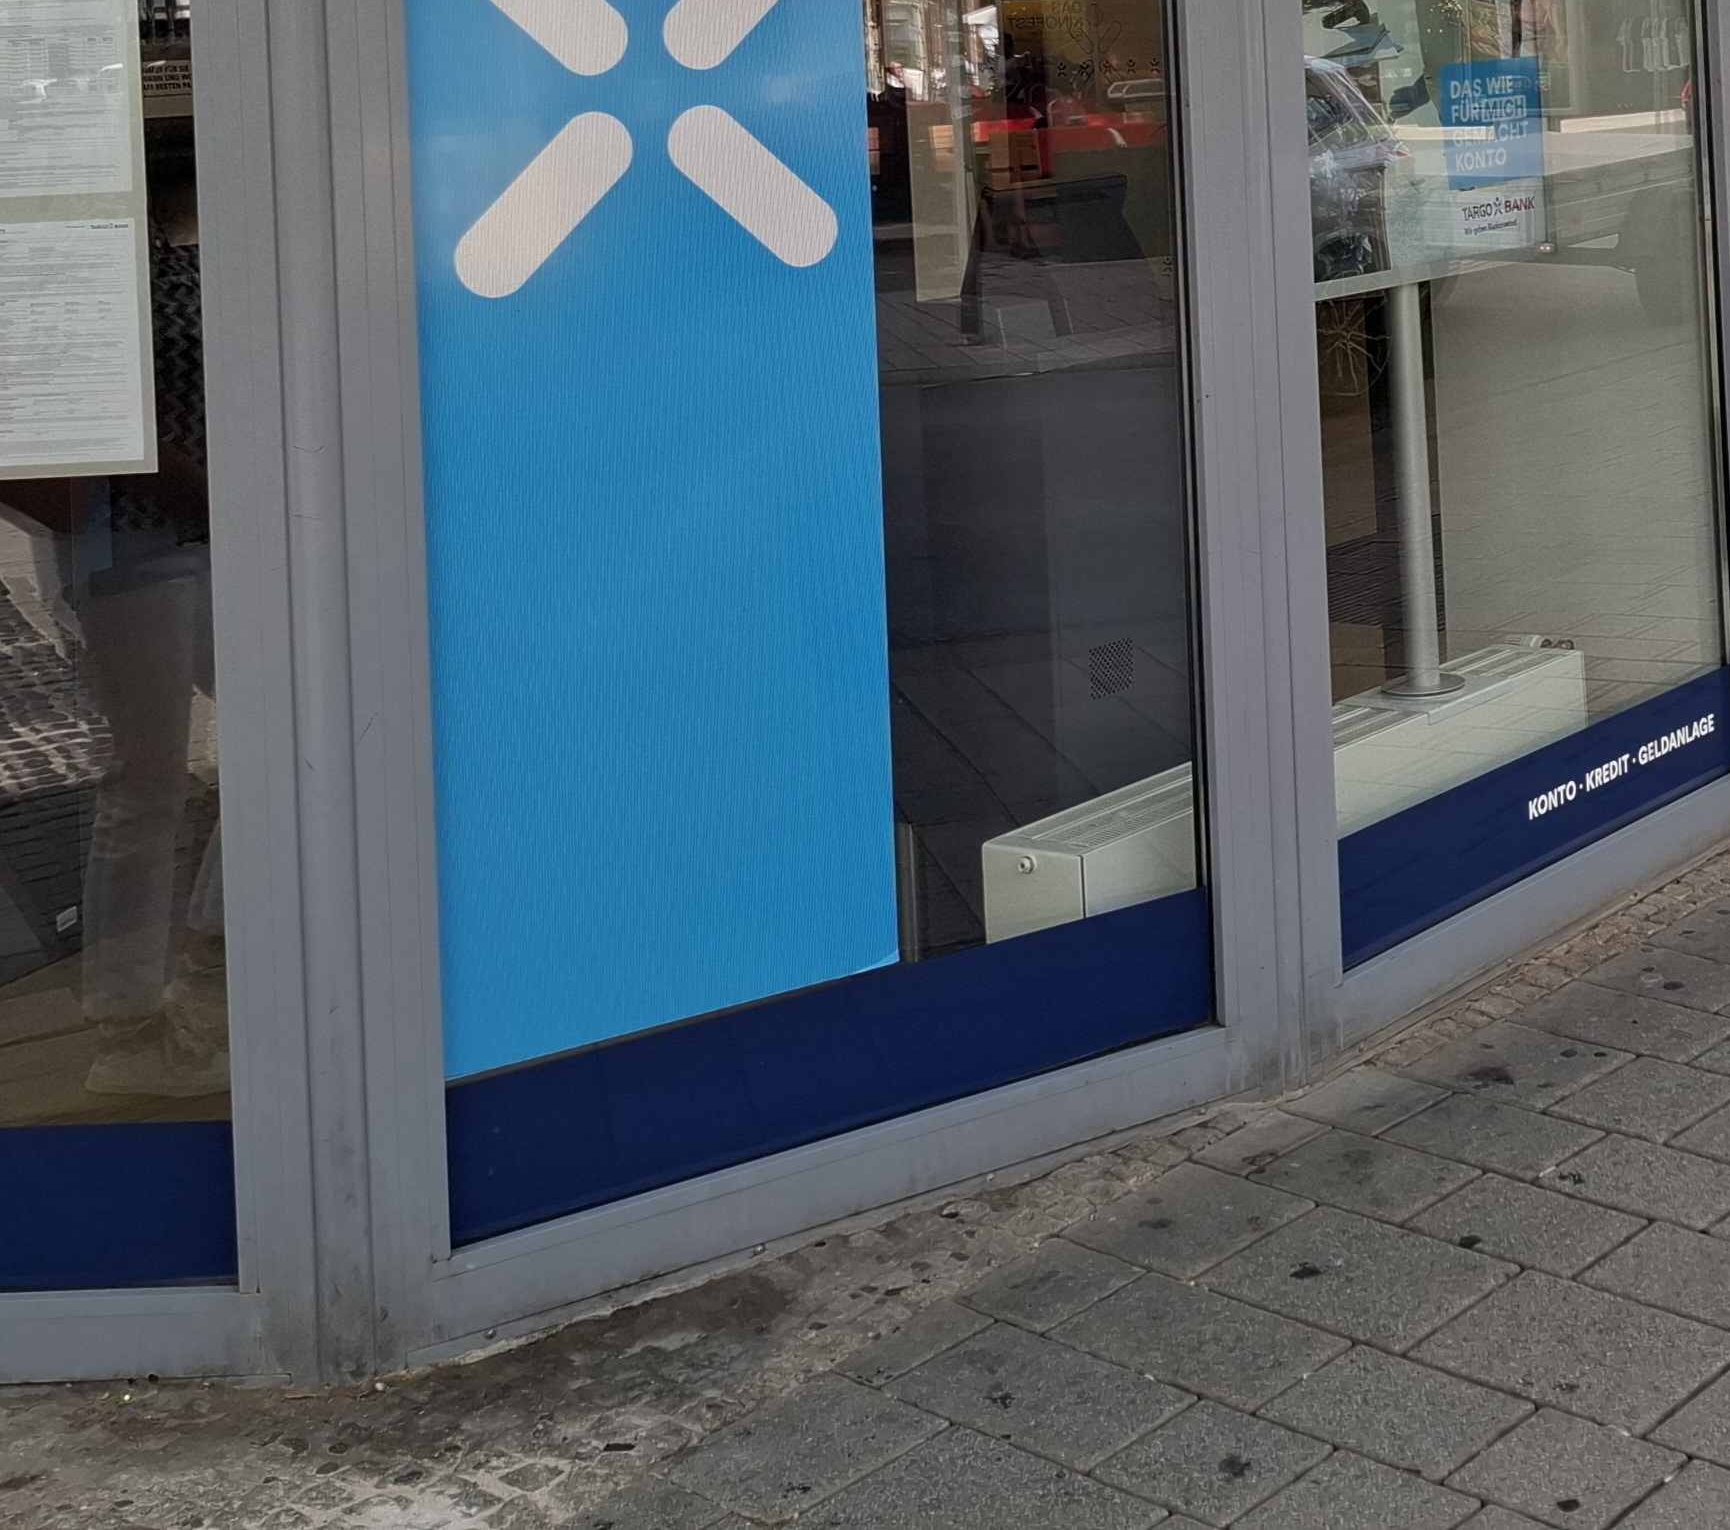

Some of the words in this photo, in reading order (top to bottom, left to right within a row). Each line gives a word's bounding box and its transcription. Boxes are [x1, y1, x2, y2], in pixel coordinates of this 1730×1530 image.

[1450, 79, 1483, 99] DAS
[1485, 75, 1515, 95] WIE
[1451, 99, 1481, 123] FÜR
[1484, 97, 1525, 120] MICH
[1453, 121, 1529, 146] GEMACHT
[1455, 147, 1507, 171] KONTO
[1461, 202, 1493, 221] TARGO
[1504, 196, 1536, 214] BANK
[1528, 781, 1577, 820] KONTO
[1585, 753, 1630, 792] KREDIT
[1638, 713, 1715, 765] GELDANLAGE
